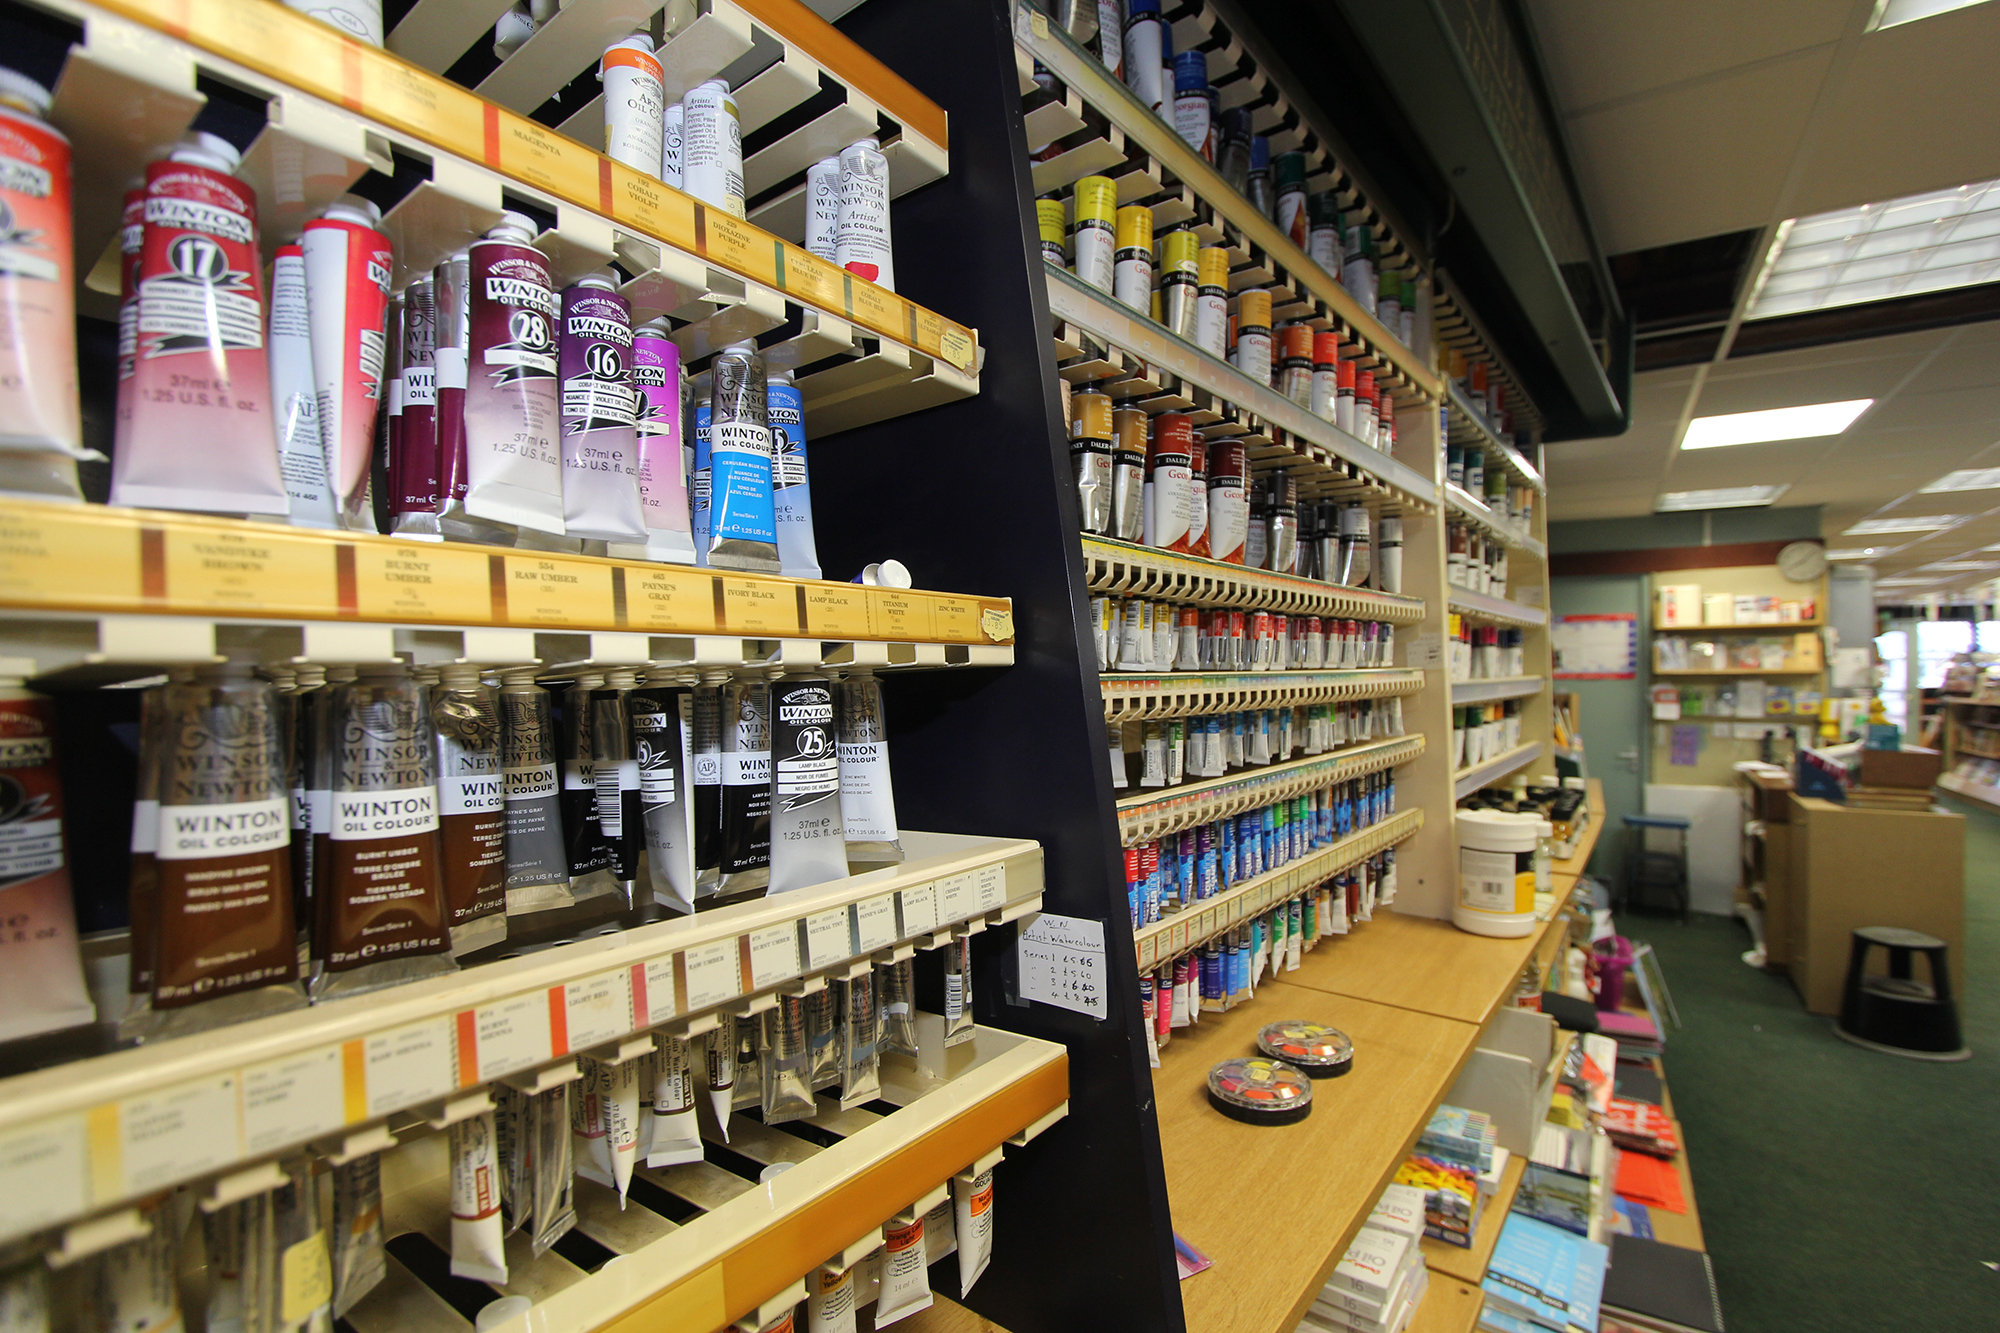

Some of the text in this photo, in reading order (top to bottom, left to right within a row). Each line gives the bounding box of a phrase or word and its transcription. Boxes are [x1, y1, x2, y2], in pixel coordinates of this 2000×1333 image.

[513, 128, 562, 157] MAGENTA
[626, 181, 660, 201] COBALT
[841, 182, 884, 199] WINSOR
[628, 191, 659, 210] VIOLET
[840, 197, 885, 212] NEWTON
[148, 202, 250, 236] WINTON
[848, 210, 880, 223] Artists'
[712, 221, 751, 244] DIOXAZINE
[840, 222, 885, 234] OIL COLOUR
[717, 232, 747, 251] PURPLE
[178, 240, 218, 278] 17
[487, 258, 525, 276] WINSOR
[500, 295, 520, 305] OIL
[570, 297, 631, 326] WINSOR NEWTON
[518, 313, 546, 348] 28
[570, 317, 632, 343] WINTON
[578, 331, 631, 349] OIL COLOUR
[519, 354, 546, 367] Magenta
[592, 346, 616, 377] 16
[410, 390, 428, 399] OIL
[600, 383, 618, 393] VIOLET
[595, 396, 614, 405] VIOLET
[775, 391, 799, 407] NEWTON
[769, 418, 798, 426] COLOUR
[720, 427, 770, 444] WINTON
[492, 442, 517, 454] 1.25
[722, 439, 737, 447] OIL
[584, 447, 610, 460] 37ml
[589, 461, 611, 472] U.S.
[722, 460, 748, 468] CERULEAN
[733, 469, 752, 478] NUANCE
[741, 527, 762, 536] 1.25 US
[385, 559, 431, 572] BURNT
[385, 572, 433, 585] UMBER
[514, 570, 579, 585] RAW UMBER
[641, 581, 677, 592] PAYNE'S
[647, 592, 672, 602] GRAY
[727, 588, 776, 600] IVORY BLACK
[809, 595, 849, 606] LAMP BLACK
[882, 600, 909, 609] TITANIUM
[950, 606, 966, 614] WHITE
[887, 608, 906, 616] WHITE
[781, 687, 809, 704] WINSOR
[781, 706, 832, 719] WINTON
[803, 717, 832, 725] COLOUR
[803, 730, 824, 755] 25
[341, 744, 429, 762] WINSOR
[798, 761, 812, 769] LAMP
[846, 756, 877, 764] COLOUR
[341, 766, 430, 788] NEWTON
[512, 784, 553, 795] COLOUR
[340, 796, 433, 818] WINTON
[464, 799, 484, 808] OIL
[175, 809, 282, 833] WINTON
[343, 815, 432, 832] OIL COLOUR
[474, 822, 495, 831] BURNT
[798, 817, 820, 830] 37ml
[472, 833, 492, 842] TERRE
[783, 829, 822, 841] 1.25 U.S.
[355, 846, 419, 861] BURNT UMBER
[353, 864, 382, 875] TERRE
[469, 858, 494, 868] SOMBRA
[519, 874, 535, 882] 1.25
[535, 873, 547, 881] US
[348, 887, 426, 905] SOMBRA TOSTADA
[365, 884, 397, 895] TIERRA
[944, 886, 961, 895] CHINESE
[945, 892, 958, 900] WHITE
[903, 896, 928, 907] LAMP BLACK
[877, 906, 889, 915] GRAY
[809, 920, 844, 936] NEUTRAL TINT
[403, 940, 420, 950] US
[752, 936, 791, 953] BURNT UMBER
[1023, 949, 1049, 961] Series
[688, 955, 725, 971] RAW UMBER
[593, 989, 609, 1001] RED
[673, 1078, 682, 1101] Colour
[888, 1230, 911, 1243] Orange
[900, 1234, 916, 1247] Light
[1361, 1250, 1387, 1268] Oil
[822, 1275, 843, 1289] Yellow
[1352, 1278, 1365, 1293] 16
[1343, 1295, 1358, 1311] 16
[1349, 1314, 1362, 1328] 16
